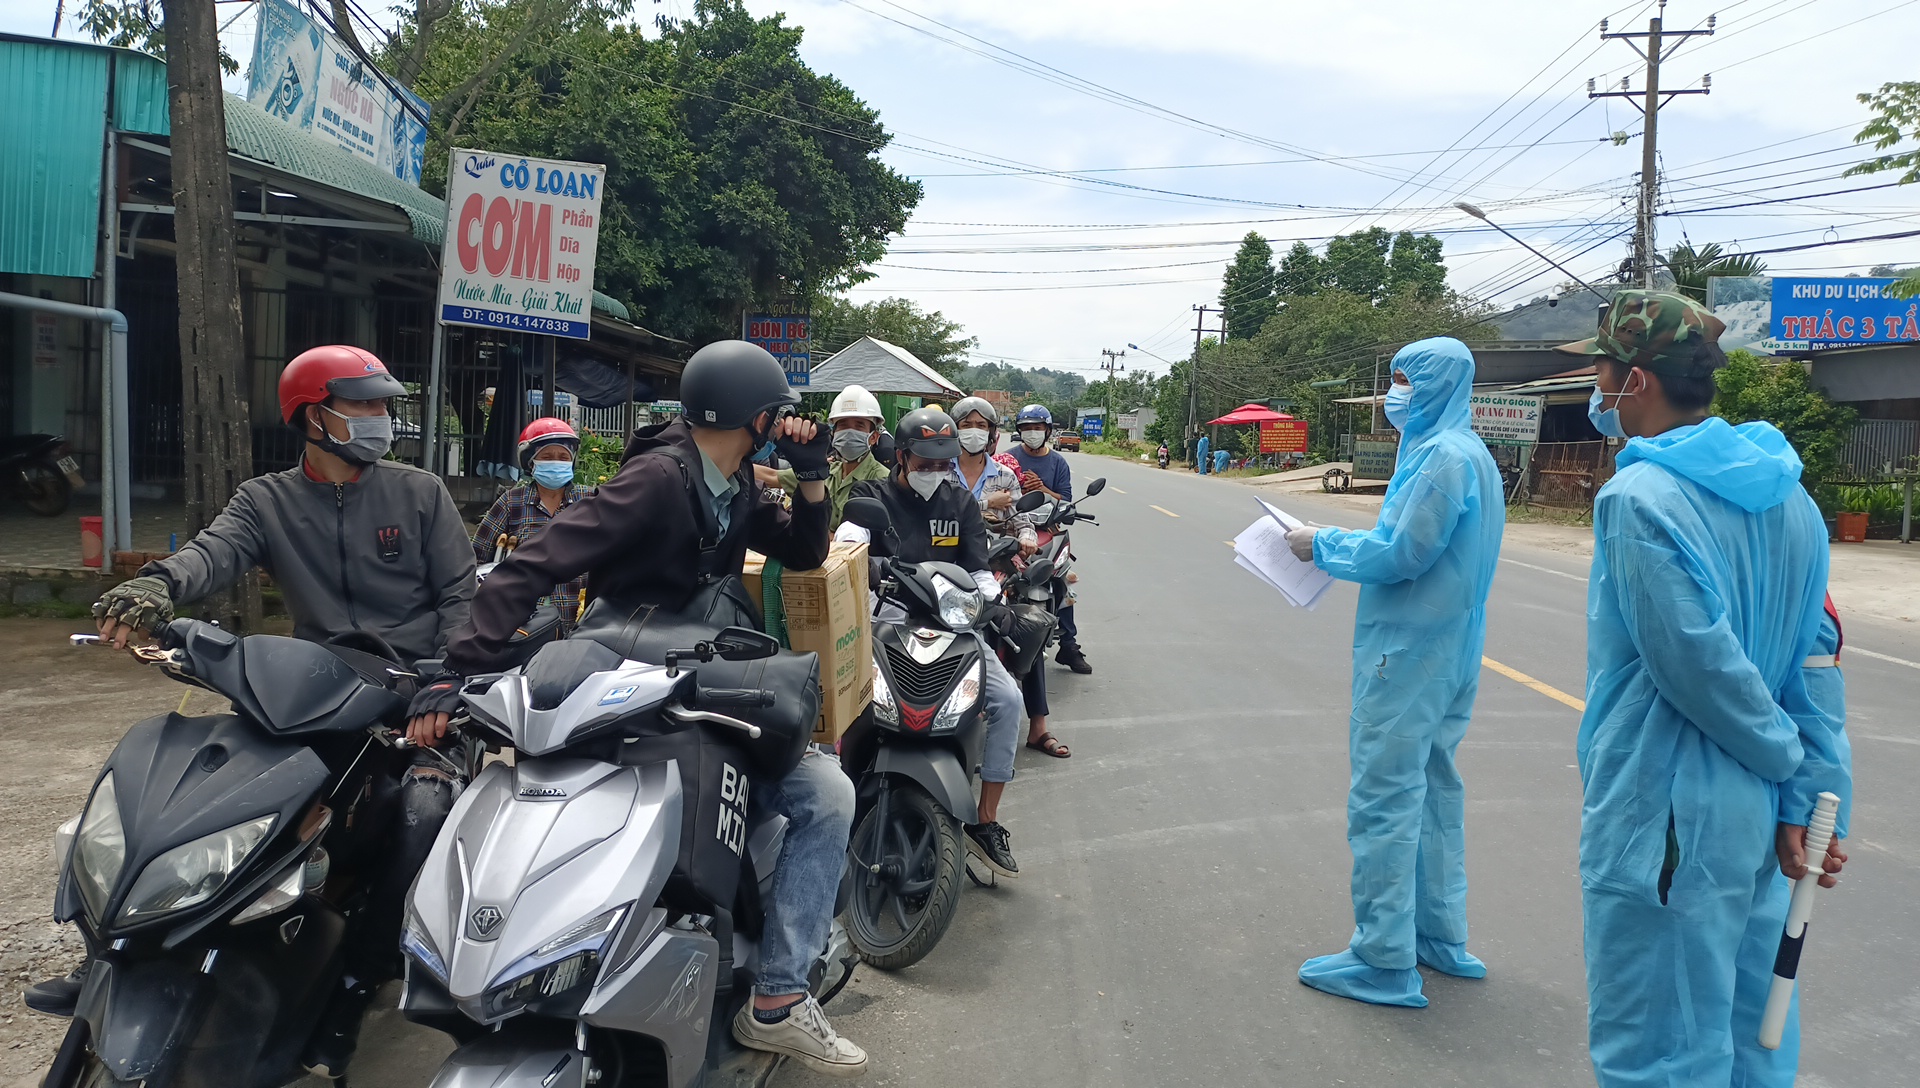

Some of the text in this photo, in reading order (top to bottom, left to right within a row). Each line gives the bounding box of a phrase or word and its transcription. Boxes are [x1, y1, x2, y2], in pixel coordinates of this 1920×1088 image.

[330, 75, 358, 114] NGỌC
[464, 155, 496, 179] Quán
[500, 159, 598, 200] CÔ LOAN
[562, 208, 593, 228] Phần
[457, 192, 554, 284] CƠM
[559, 236, 580, 254] Dĩa
[557, 263, 580, 283] Hộp
[453, 278, 583, 315] Nước Mía Giải Khát
[1792, 284, 1820, 298] KHU
[1825, 285, 1843, 299] DU
[1848, 285, 1879, 303] LỊCH
[462, 308, 570, 333] ĐT: 0914.147838
[749, 319, 782, 339] BÚN
[1781, 308, 1855, 339] THÁC
[1860, 316, 1876, 338] 3
[770, 342, 789, 353] HEO
[1761, 341, 1780, 349] Vào
[777, 354, 807, 374] ơm
[1492, 396, 1507, 405] CÂY
[1508, 397, 1537, 407] GIỐNG
[1475, 406, 1525, 419] QUANG HUY
[519, 787, 566, 796] HONDA
